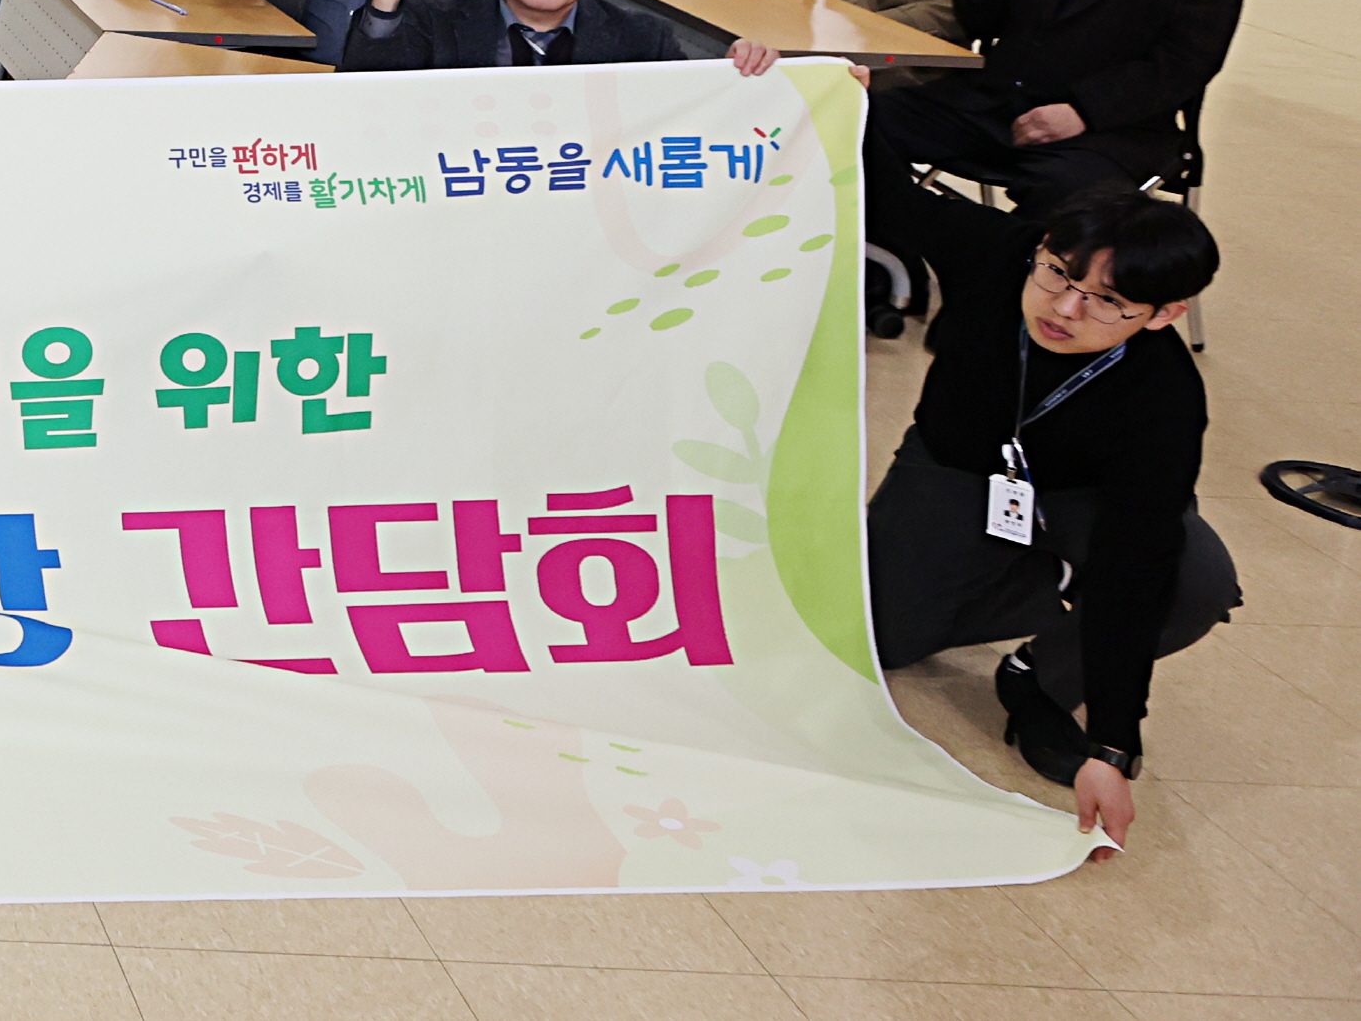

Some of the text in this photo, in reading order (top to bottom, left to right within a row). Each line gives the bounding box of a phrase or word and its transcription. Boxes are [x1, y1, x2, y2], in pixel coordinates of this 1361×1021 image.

[168, 138, 318, 174] 구민을 편하게
[438, 136, 765, 198] 남동을 새롭게
[242, 172, 427, 209] 경제를 활기차게
[155, 326, 387, 434] 위한
[121, 484, 735, 676] 간담회
